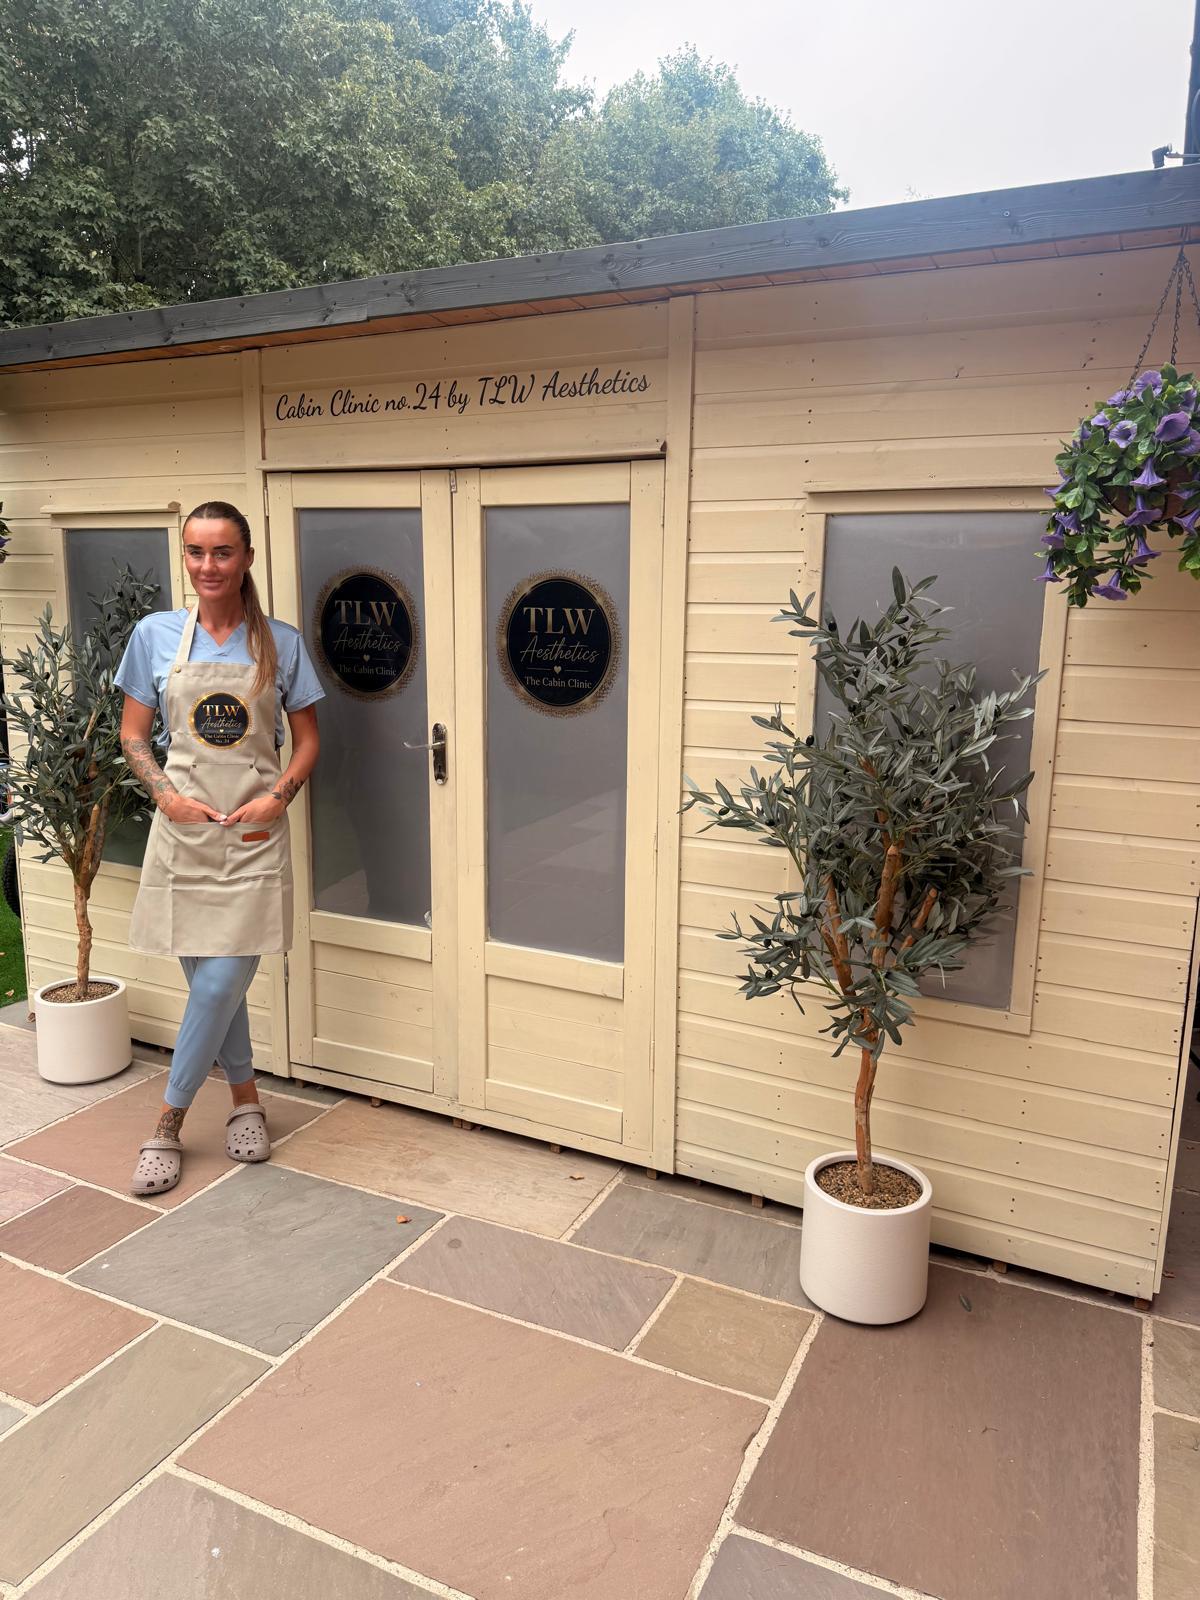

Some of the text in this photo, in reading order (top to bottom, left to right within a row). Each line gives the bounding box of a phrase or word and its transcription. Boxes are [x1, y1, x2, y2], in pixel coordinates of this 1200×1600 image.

[276, 393, 324, 421] Cabin
[330, 389, 381, 417] Clinic
[447, 380, 471, 414] by
[478, 373, 536, 406] TLW
[541, 367, 652, 400] Aesthetics
[334, 600, 397, 627] TLW
[523, 606, 596, 635] TLW
[333, 626, 402, 652] Aesthetics
[520, 635, 600, 664] Aesthetics
[338, 664, 352, 673] The
[375, 667, 397, 676] Clinic
[524, 676, 592, 689] The Cabin Clinic
[201, 717, 241, 730] Aesthetics
[202, 704, 240, 717] TLW
